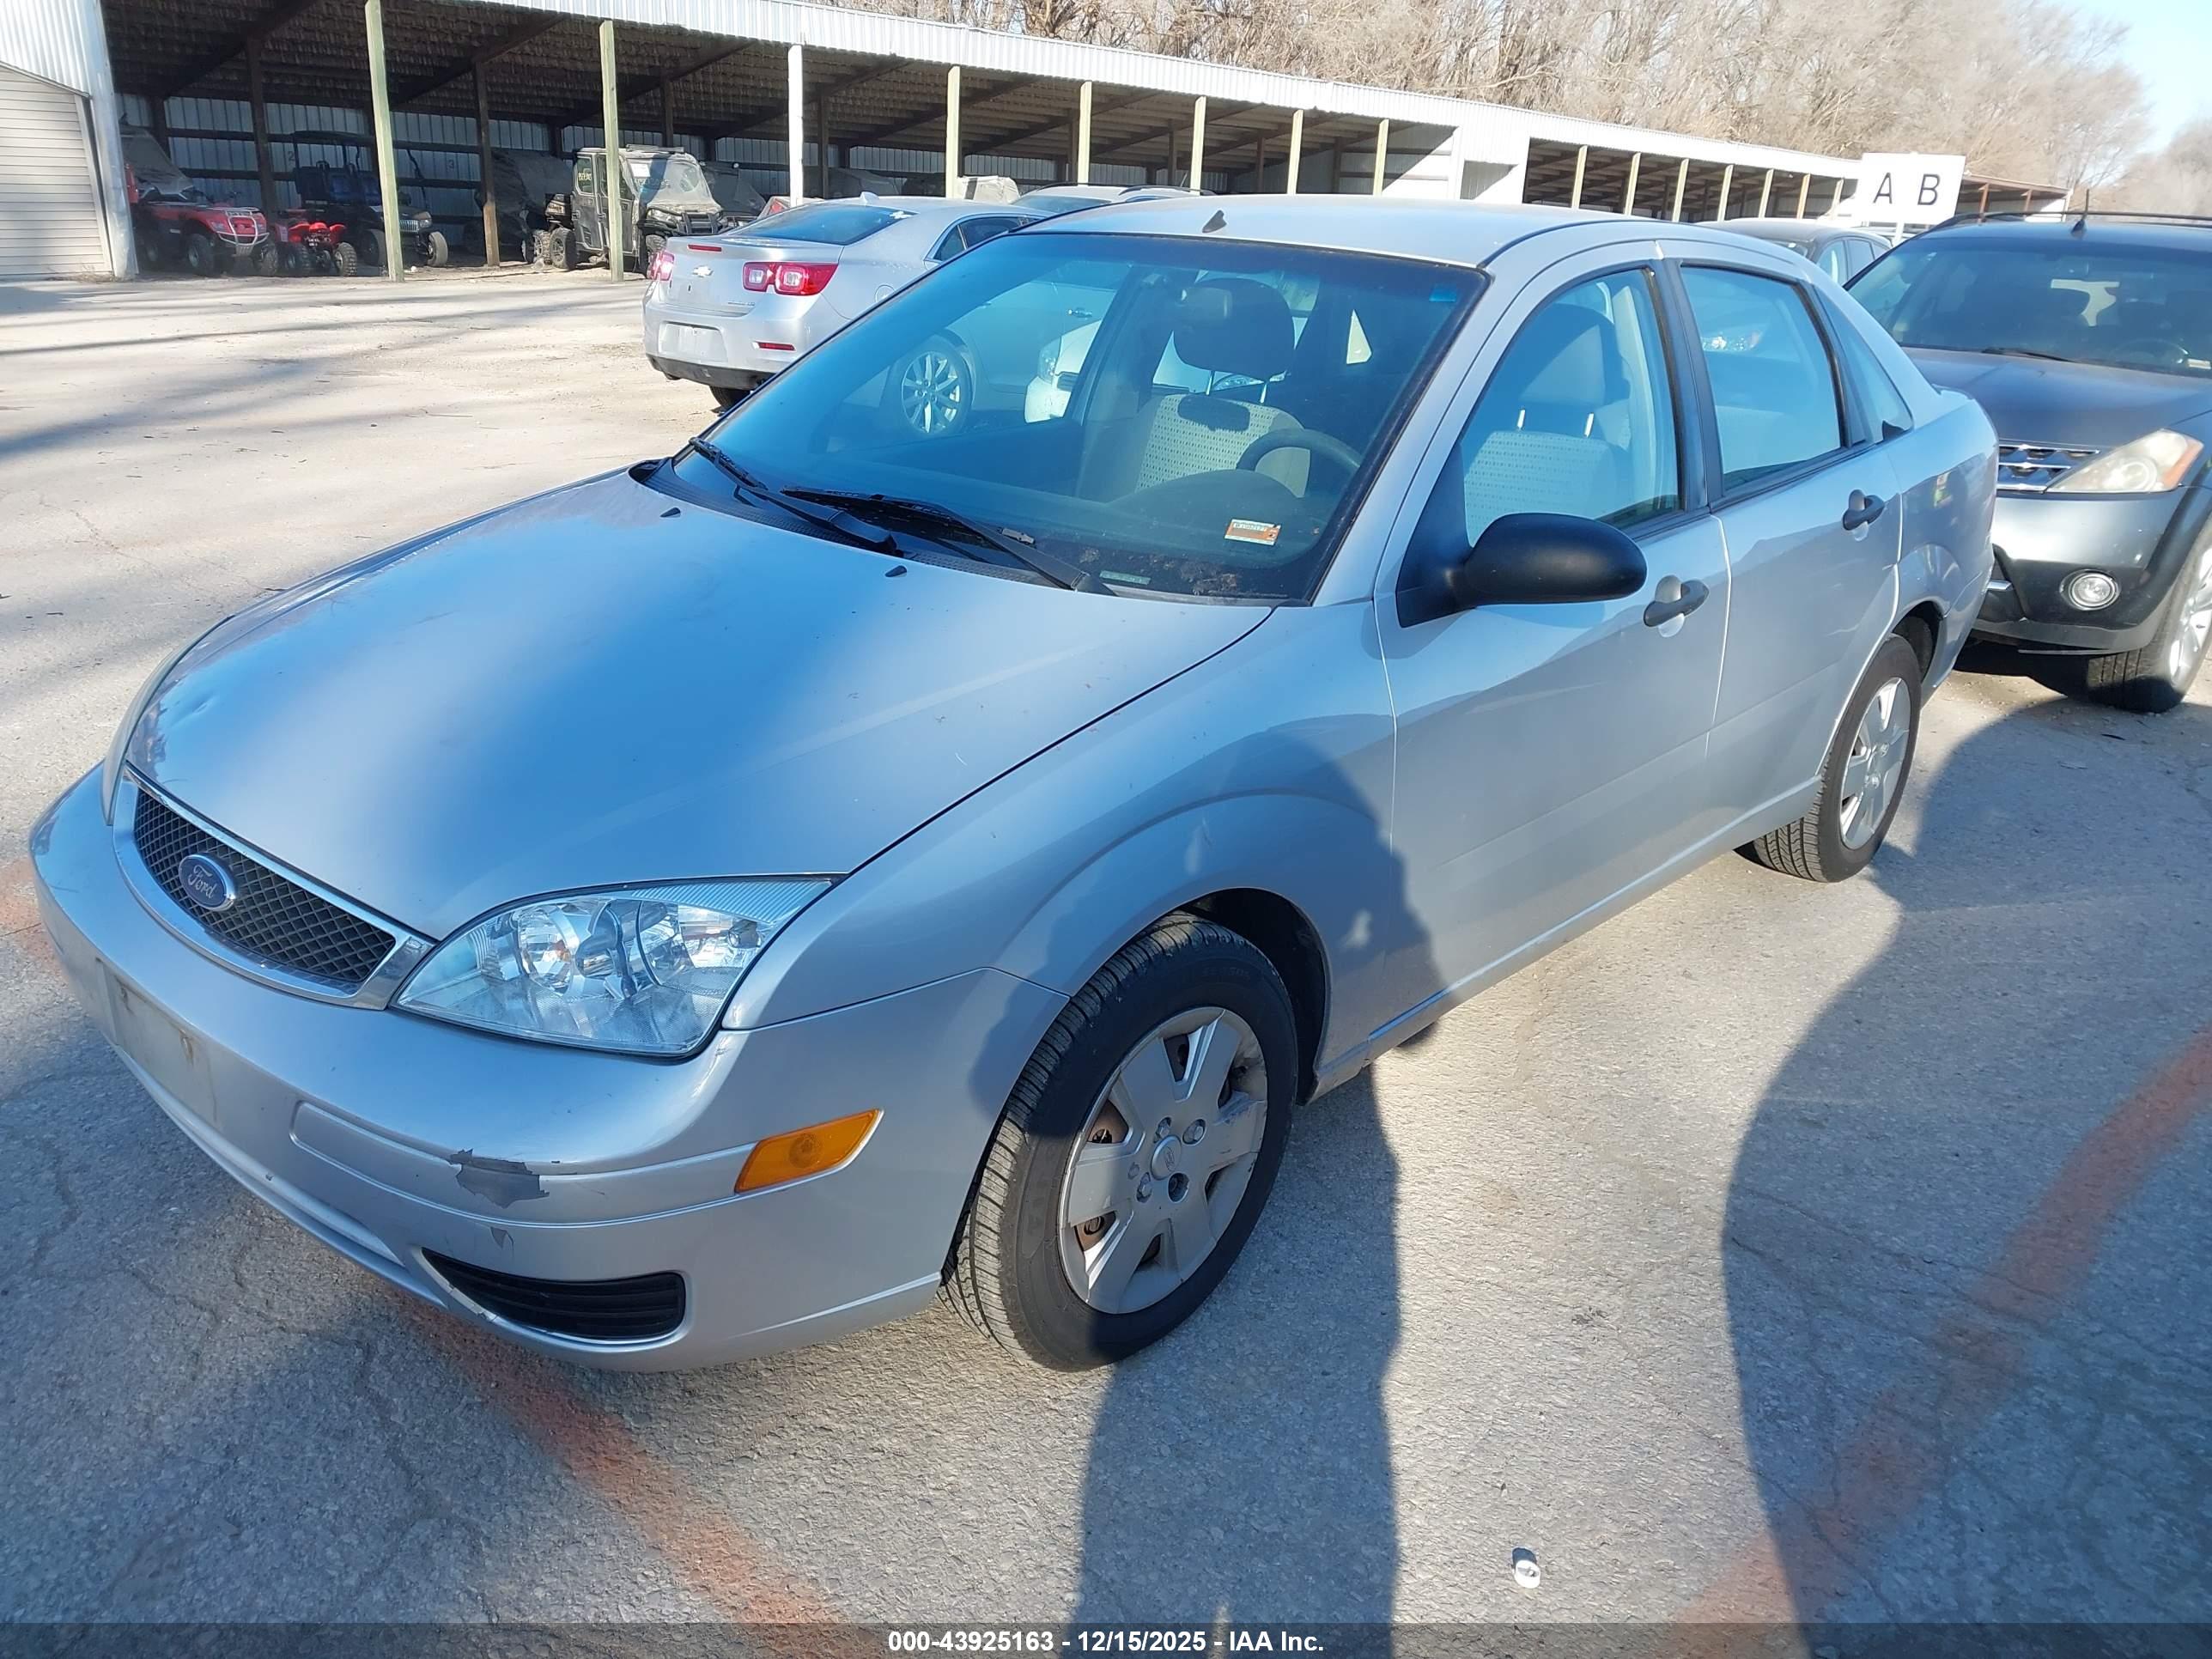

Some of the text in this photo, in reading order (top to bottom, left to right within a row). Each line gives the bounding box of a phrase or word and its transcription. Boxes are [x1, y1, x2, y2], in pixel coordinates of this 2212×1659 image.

[1873, 172, 1941, 205] A B
[187, 864, 217, 899] Ford
